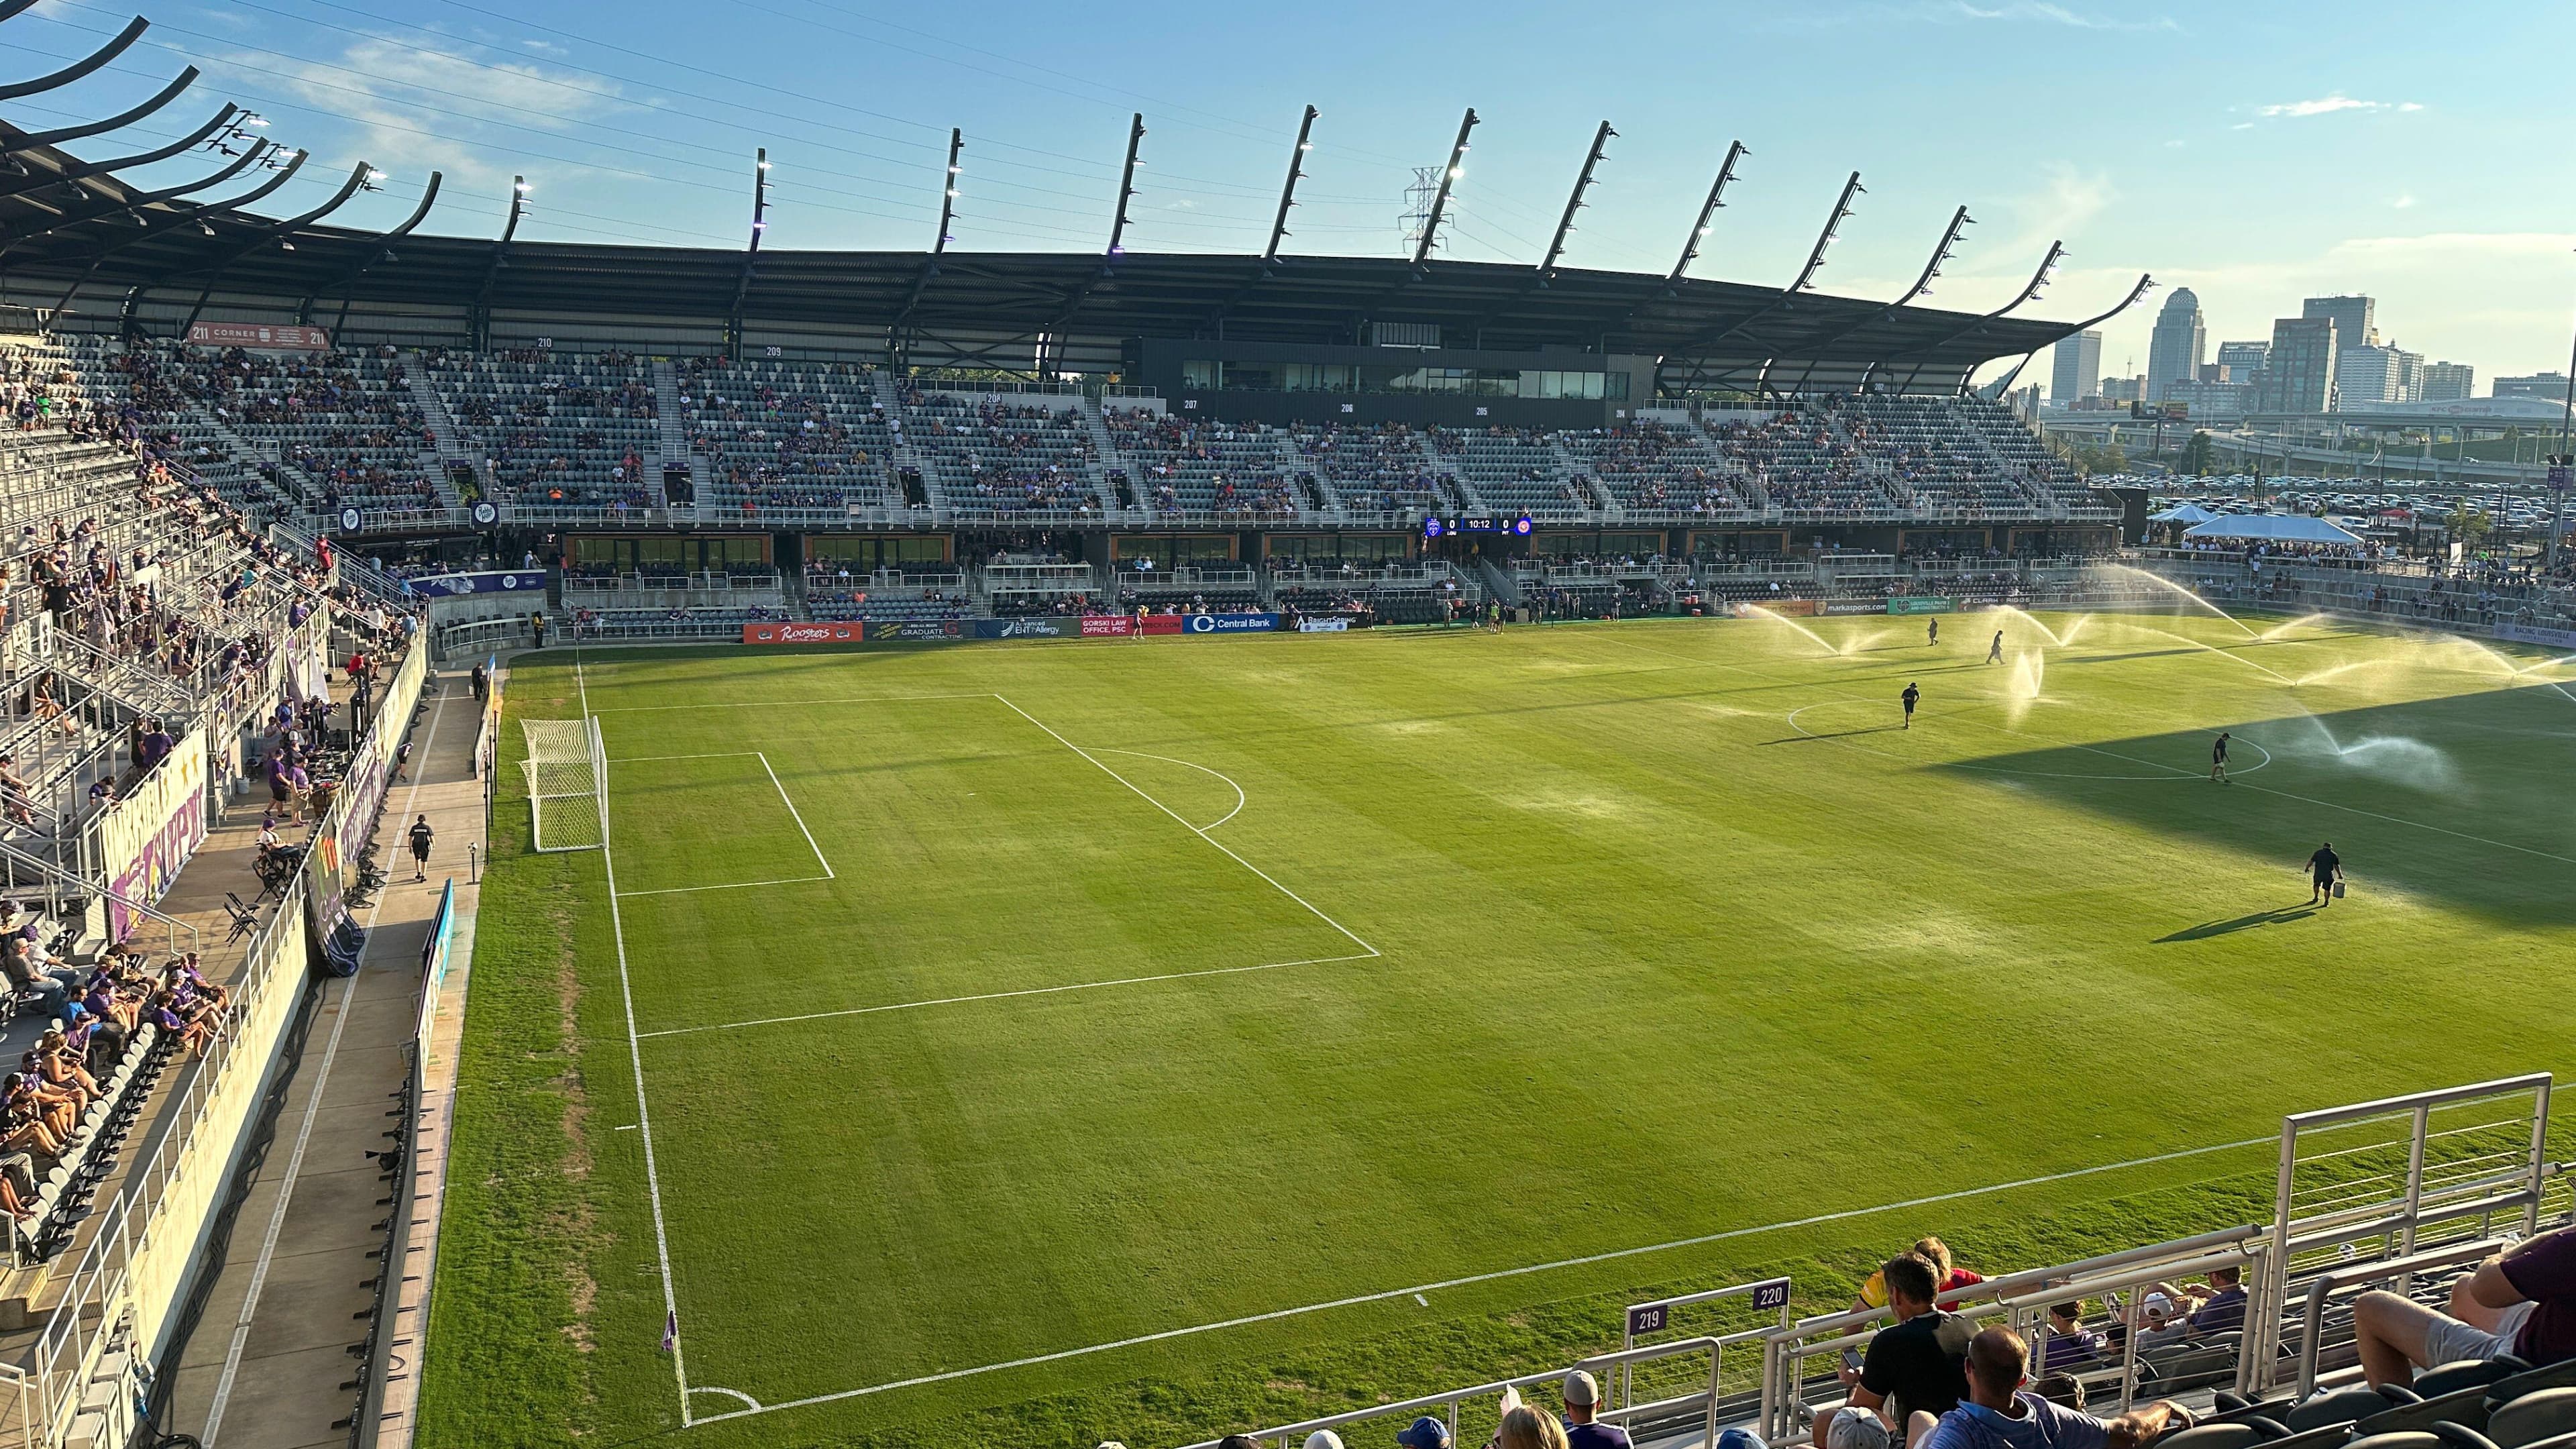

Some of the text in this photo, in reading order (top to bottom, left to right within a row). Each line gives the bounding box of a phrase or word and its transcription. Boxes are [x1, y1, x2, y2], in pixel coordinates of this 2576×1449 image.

[193, 327, 208, 339] 211
[311, 332, 324, 344] 211
[538, 337, 552, 347] 210
[767, 346, 781, 356] 209
[1185, 400, 1197, 409] 207
[1342, 404, 1353, 413] 206
[1477, 407, 1487, 416] 205
[1449, 520, 1509, 529] 0 10:12 0
[1827, 604, 1887, 612] markasports.com
[1218, 619, 1270, 628] Central Bank
[780, 626, 830, 641] Roosters
[1015, 626, 1060, 635] ENT Allergy
[2515, 627, 2570, 639] RACING LOUISVILLE
[1760, 1287, 1782, 1305] 220
[1638, 1311, 1660, 1330] 219
